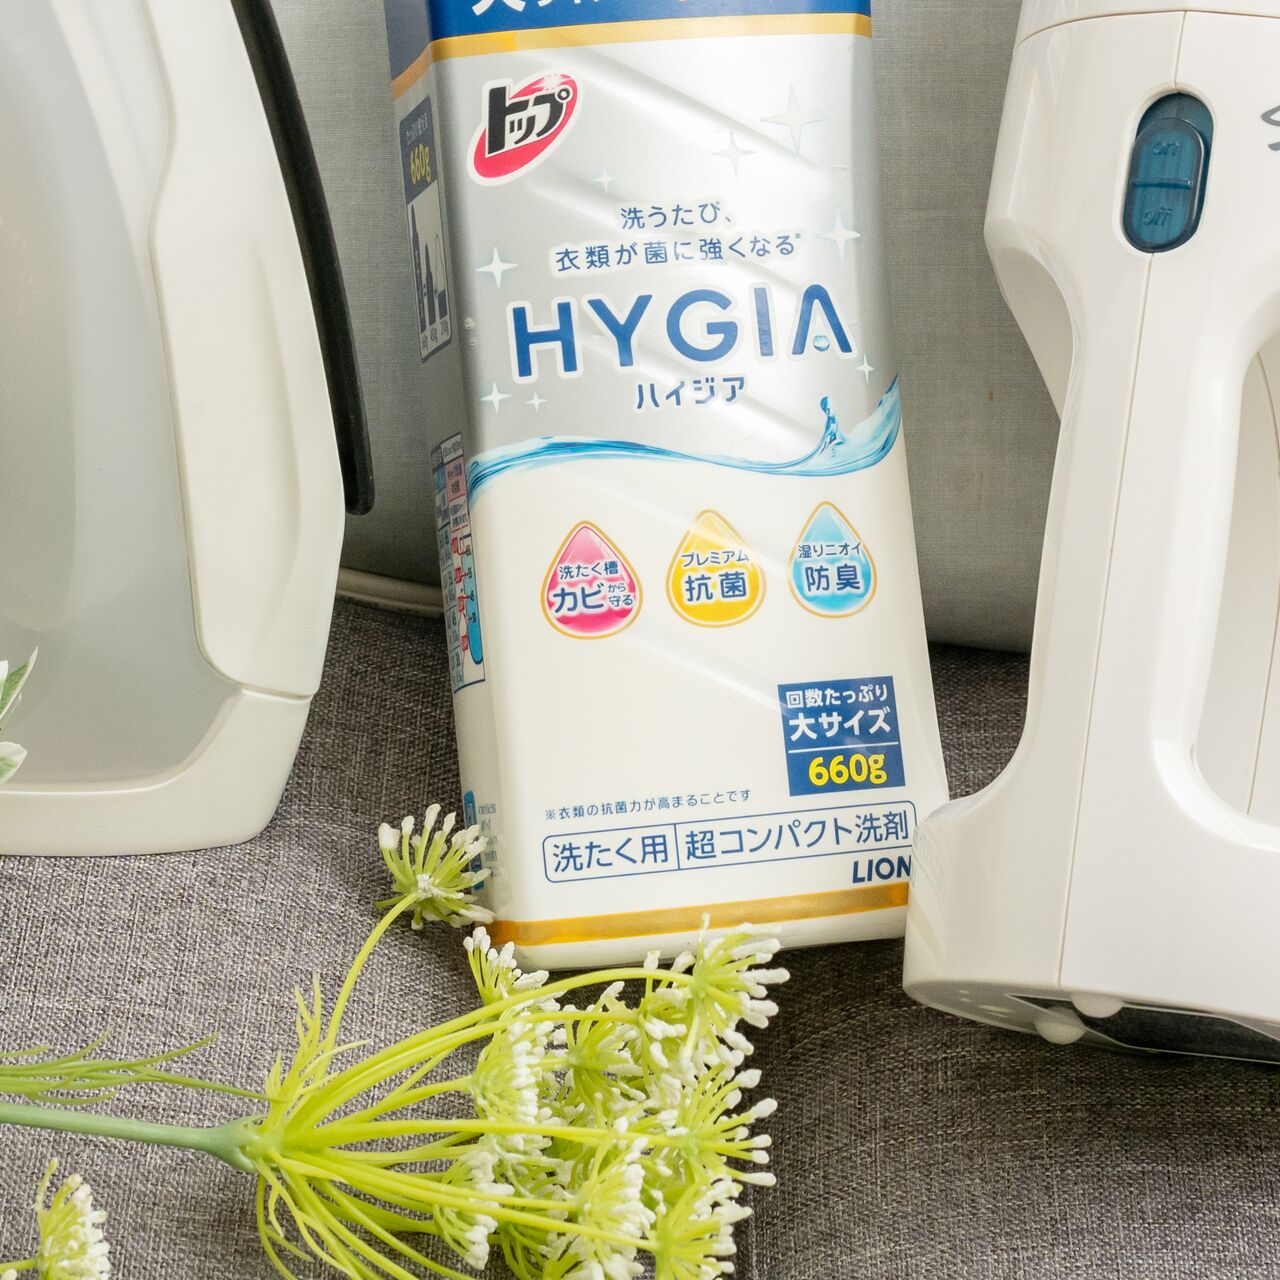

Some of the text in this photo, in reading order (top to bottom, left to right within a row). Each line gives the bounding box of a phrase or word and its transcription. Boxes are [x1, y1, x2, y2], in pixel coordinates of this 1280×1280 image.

[486, 80, 573, 156] トップ
[512, 284, 853, 377] HYGIA
[636, 376, 746, 410] ハイジア
[681, 549, 749, 568] プレミアム
[798, 542, 862, 559] 湿りニオイ
[559, 561, 619, 580] 洗たく槽
[685, 570, 747, 602] 抗菌
[805, 563, 861, 592] 防臭
[785, 682, 889, 709] 回数たっぷり
[788, 706, 892, 742] 大サイズ
[808, 753, 888, 787] 660g
[552, 834, 670, 873] 洗たく用
[685, 809, 909, 861] 超コンパクト洗剤
[852, 855, 912, 884] LION
